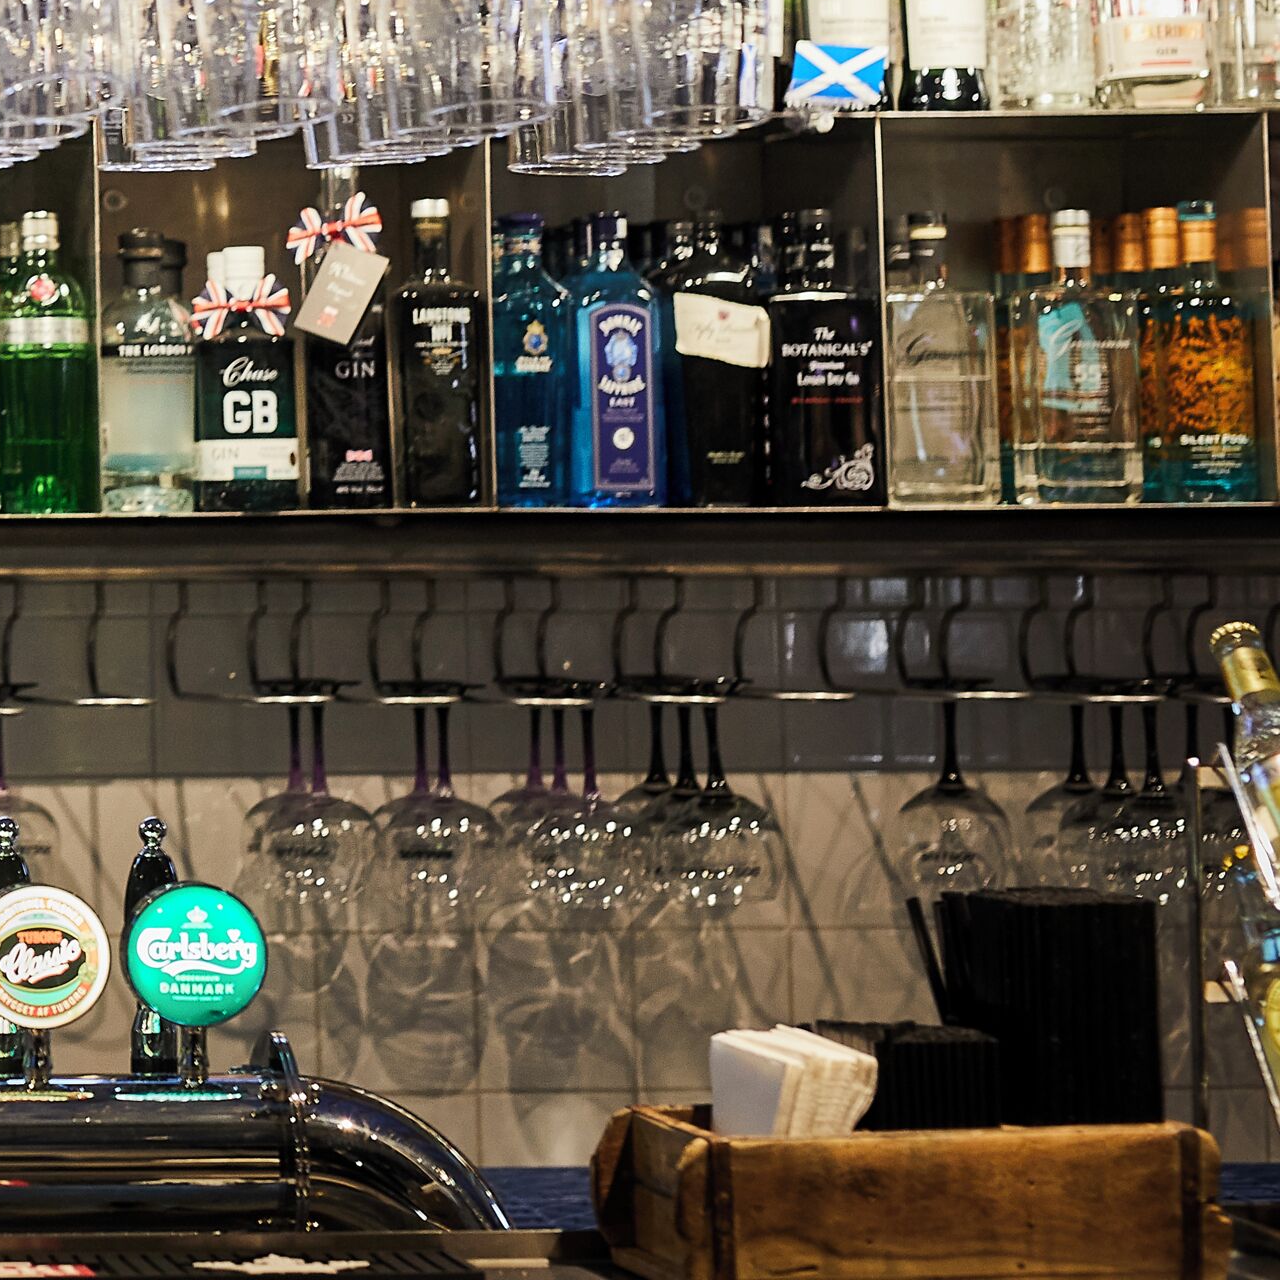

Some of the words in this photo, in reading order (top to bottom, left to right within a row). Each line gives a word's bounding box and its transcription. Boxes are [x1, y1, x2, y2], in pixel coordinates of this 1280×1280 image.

[222, 356, 279, 388] Chase
[335, 361, 376, 380] GIN
[222, 389, 278, 435] GB
[211, 447, 240, 461] GIN
[0, 938, 82, 984] Classic
[136, 927, 258, 977] Carlsberg
[159, 982, 235, 994] DANMARK
